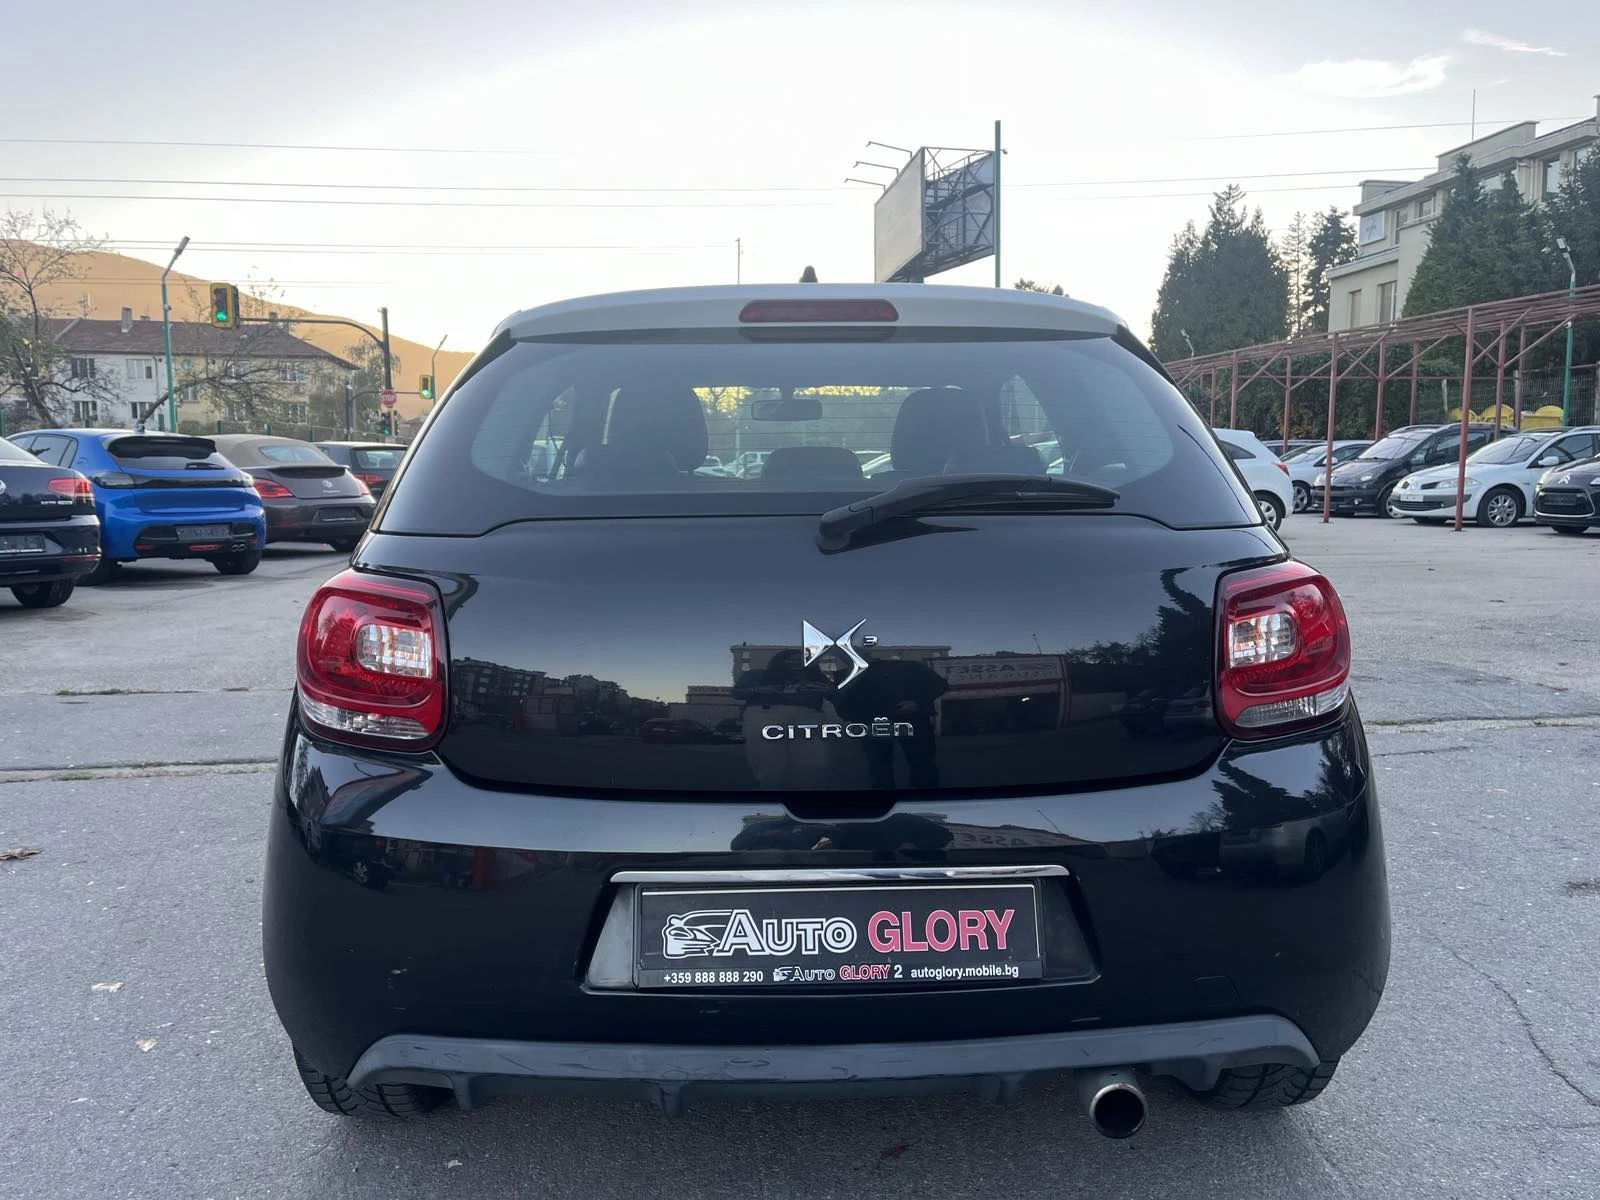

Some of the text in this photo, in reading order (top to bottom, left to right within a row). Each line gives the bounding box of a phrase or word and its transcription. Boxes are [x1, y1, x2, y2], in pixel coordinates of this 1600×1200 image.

[380, 394, 396, 402] STOP
[867, 909, 1015, 953] GLORY
[663, 971, 764, 984] +359 888 888 290
[839, 964, 891, 981] GLORY
[893, 965, 903, 979] 2
[910, 964, 1019, 980] autoglory.mobile.bg
